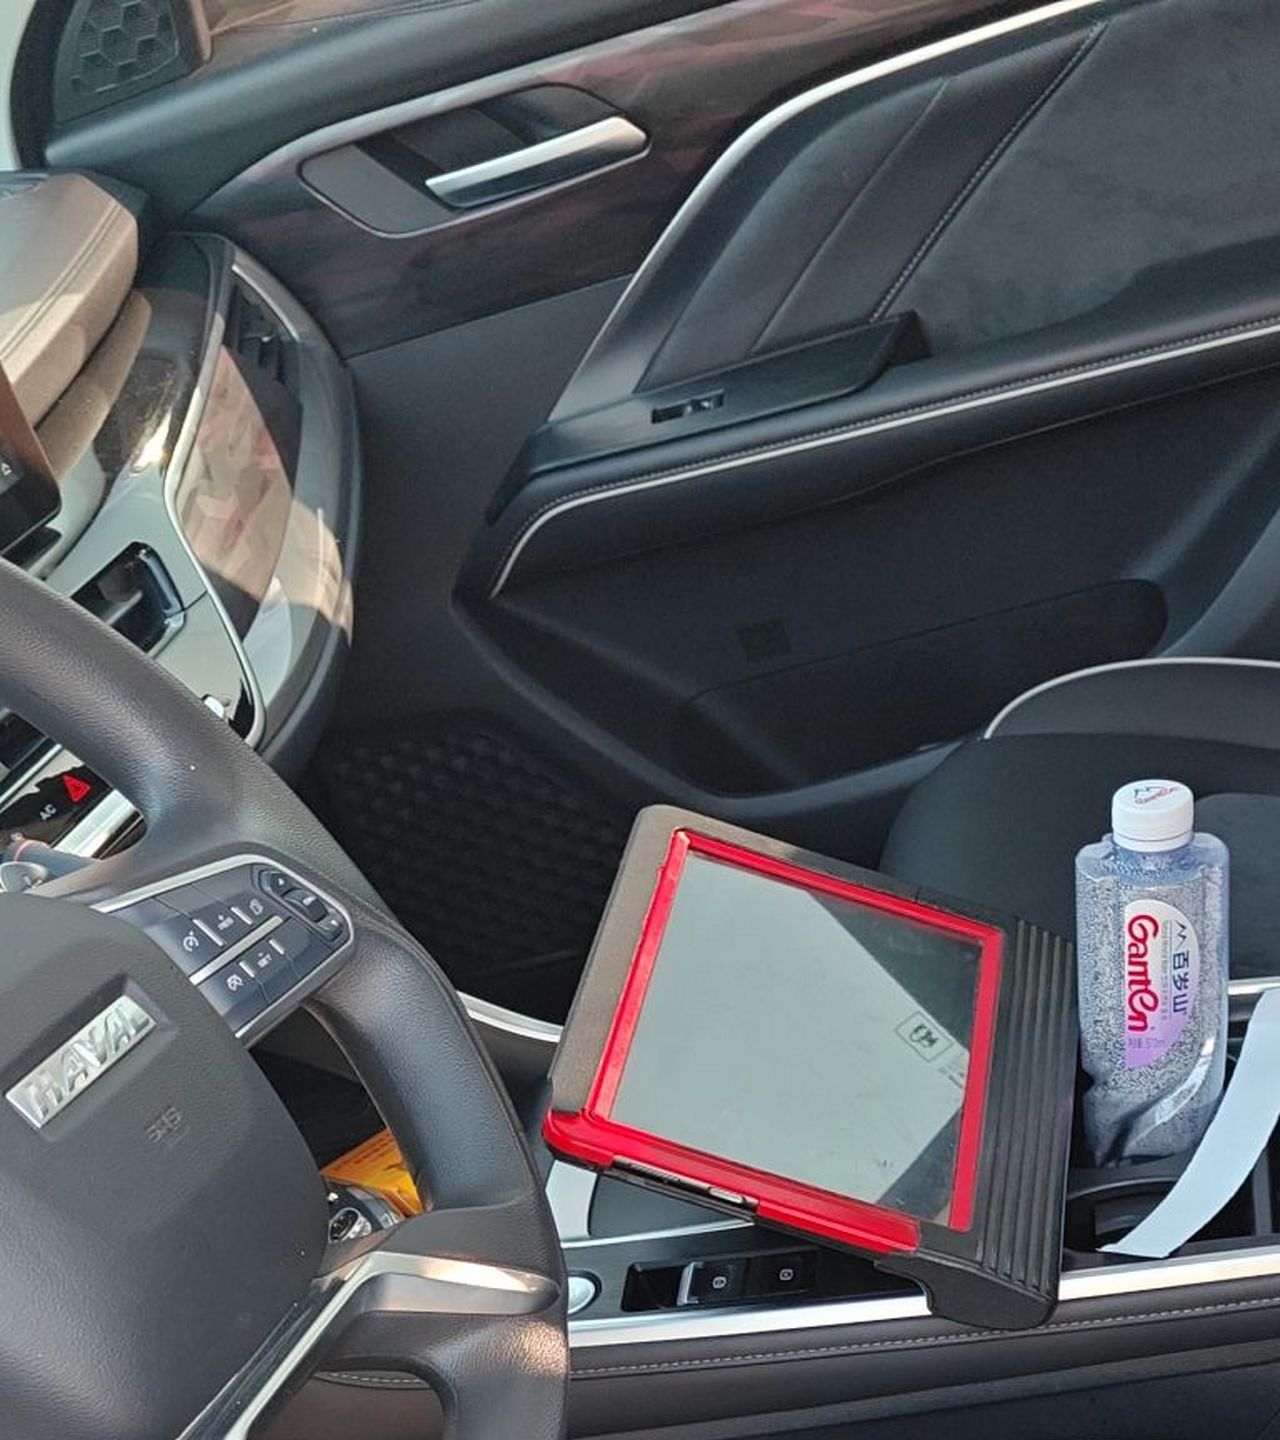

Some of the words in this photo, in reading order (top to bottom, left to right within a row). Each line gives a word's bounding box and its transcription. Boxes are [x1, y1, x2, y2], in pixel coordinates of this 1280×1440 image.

[39, 804, 57, 821] A/C
[1173, 951, 1190, 1013] 百岁山
[14, 1002, 154, 1124] HAVAL
